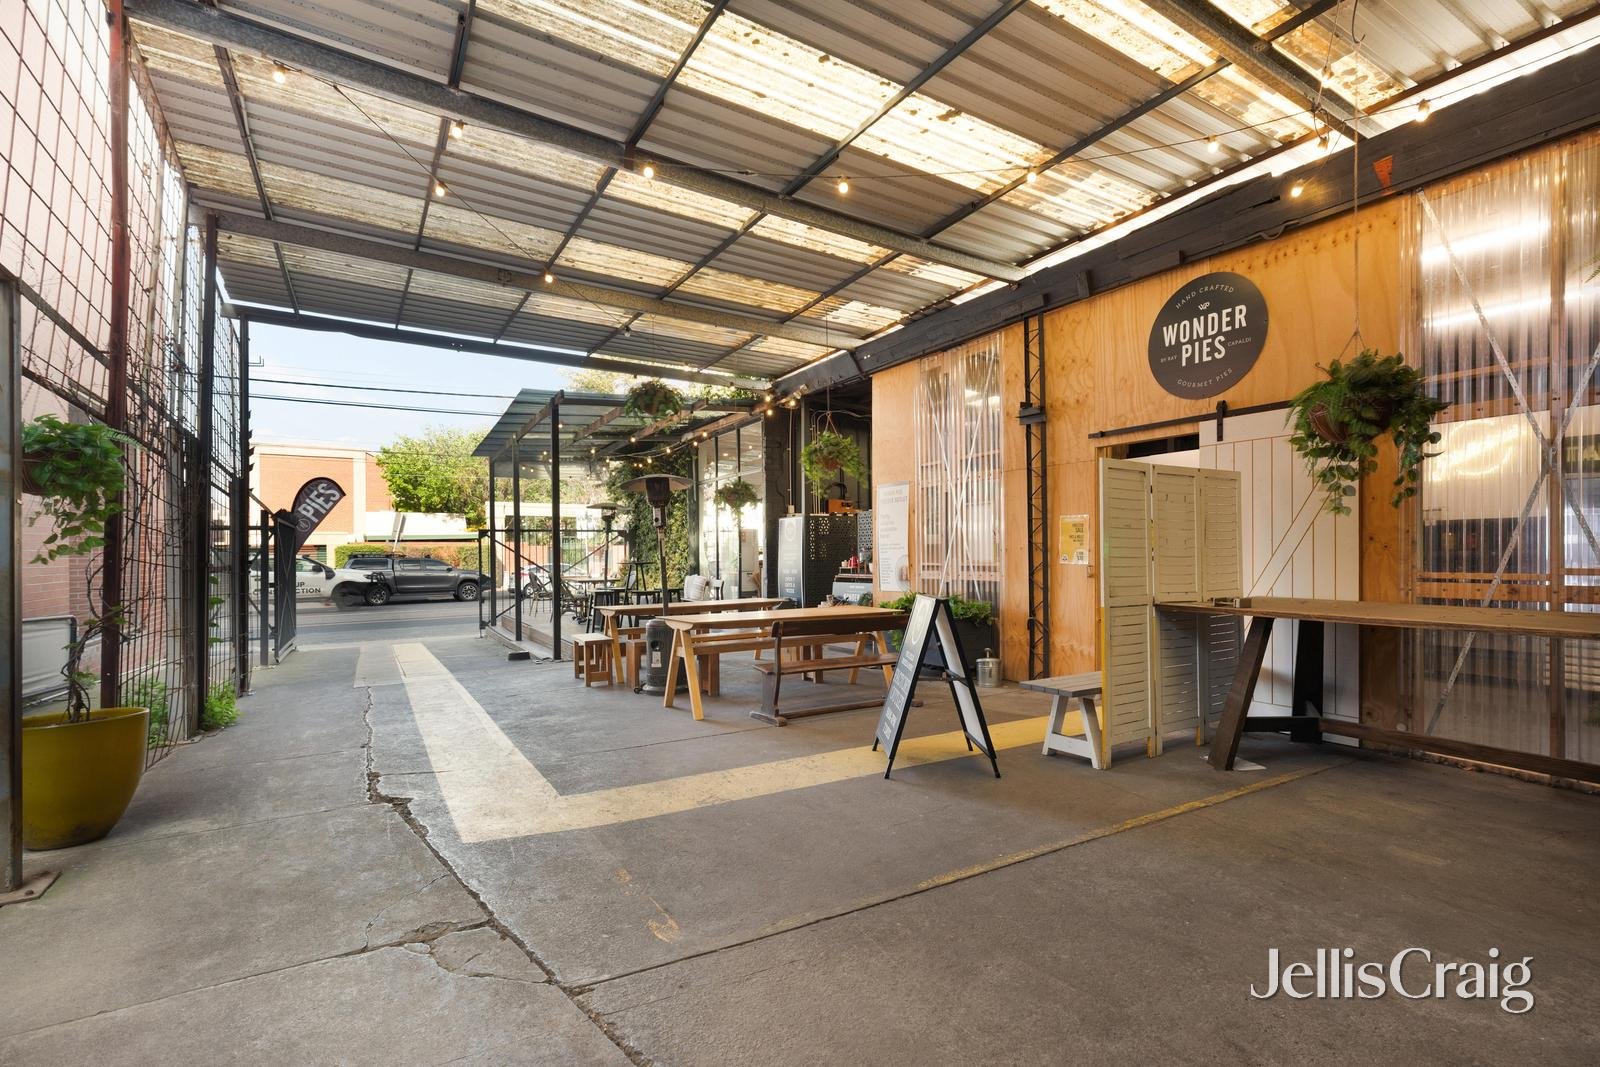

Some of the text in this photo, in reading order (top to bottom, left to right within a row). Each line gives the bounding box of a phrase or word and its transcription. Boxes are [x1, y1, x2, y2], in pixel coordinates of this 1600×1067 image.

[1176, 284, 1234, 309] HAND CRAFTED
[1163, 304, 1247, 347] WONDER
[1181, 335, 1226, 367] PIES
[1177, 368, 1233, 388] GOURMET PIES
[298, 483, 340, 523] PIES
